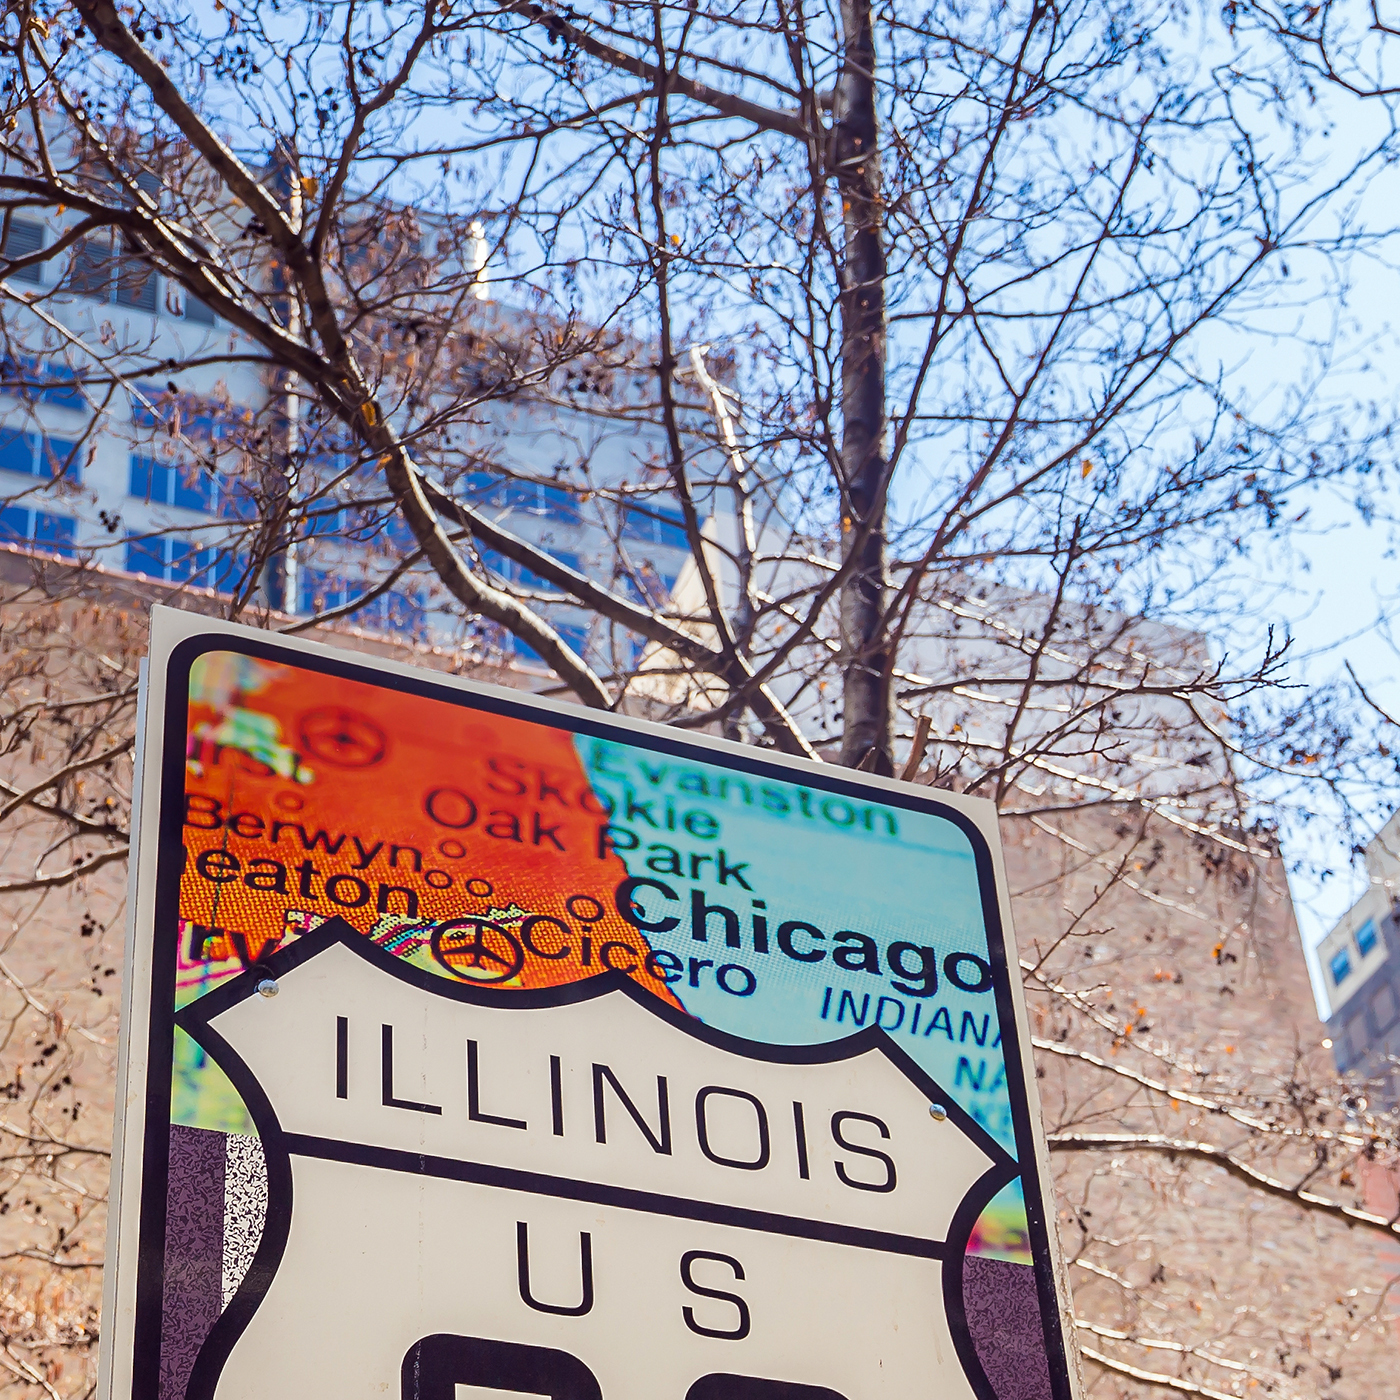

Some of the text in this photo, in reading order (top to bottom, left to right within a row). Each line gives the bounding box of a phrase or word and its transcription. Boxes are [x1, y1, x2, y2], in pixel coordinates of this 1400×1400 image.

[185, 793, 423, 873] Berwyn
[486, 756, 721, 841] Skokie
[592, 744, 899, 836] Evanston
[180, 845, 422, 918] eaton
[425, 787, 754, 891] Oak Park
[519, 914, 758, 997] Cicero
[614, 874, 994, 999] Chicago
[335, 1015, 899, 1194] ILLINOIS
[516, 1221, 752, 1341] U S
